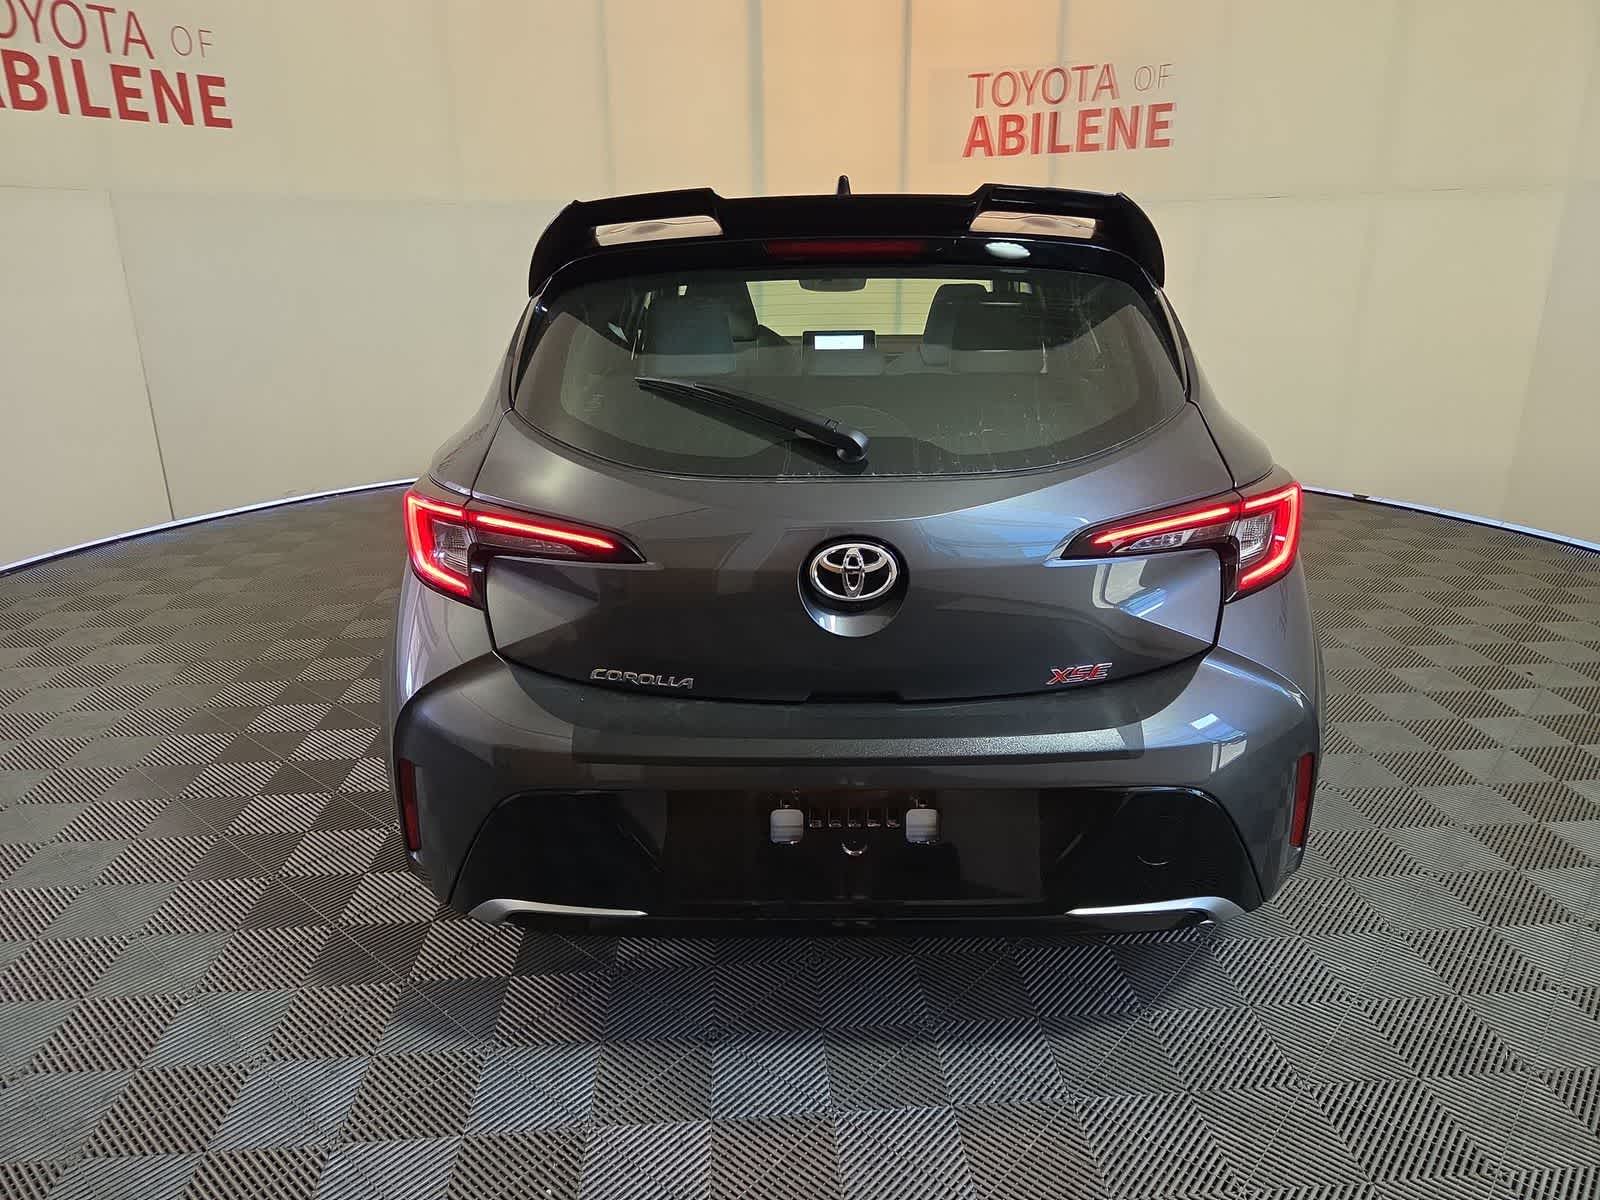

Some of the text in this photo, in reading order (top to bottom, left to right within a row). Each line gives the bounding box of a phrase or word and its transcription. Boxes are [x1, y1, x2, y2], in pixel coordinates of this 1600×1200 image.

[170, 25, 213, 58] OF
[0, 48, 233, 129] BILENE
[968, 63, 1173, 109] TOYOTA OF
[961, 102, 1176, 158] ABILENE
[589, 668, 694, 690] COROLLA
[1045, 662, 1113, 685] XSE
